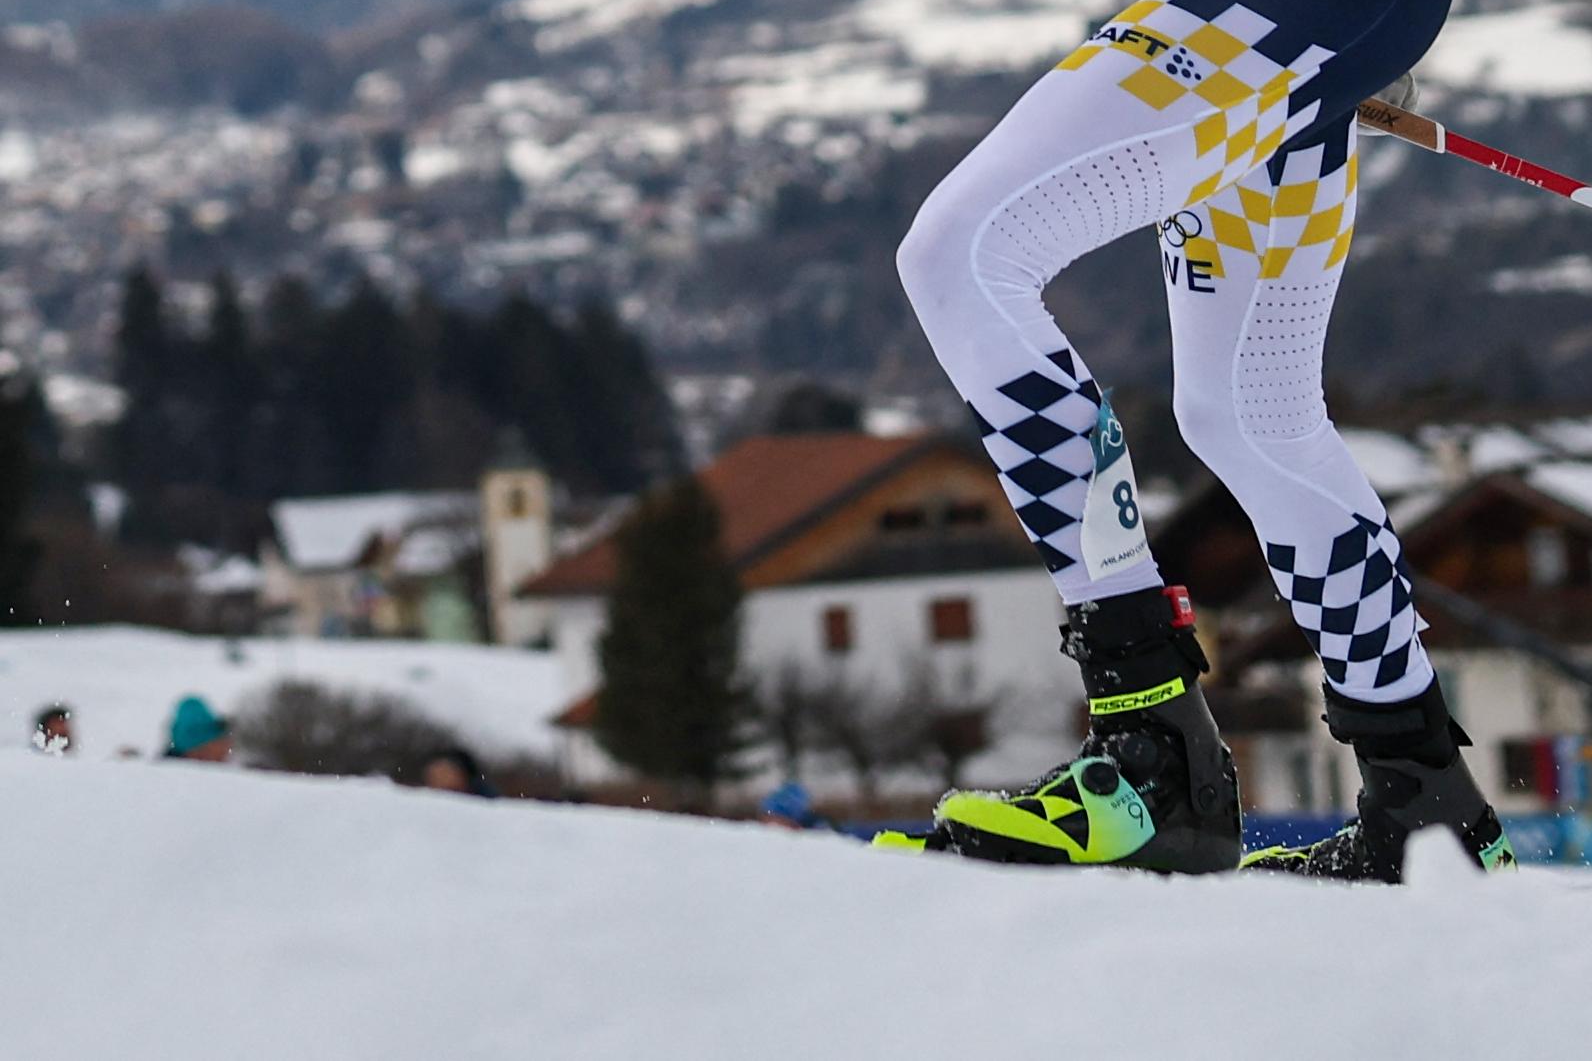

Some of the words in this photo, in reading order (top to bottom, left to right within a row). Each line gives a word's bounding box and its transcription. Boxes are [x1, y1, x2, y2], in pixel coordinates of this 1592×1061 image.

[1088, 26, 1170, 57] AFT
[1164, 250, 1216, 294] WE
[1112, 480, 1140, 530] 8
[1094, 686, 1174, 712] FISCHER
